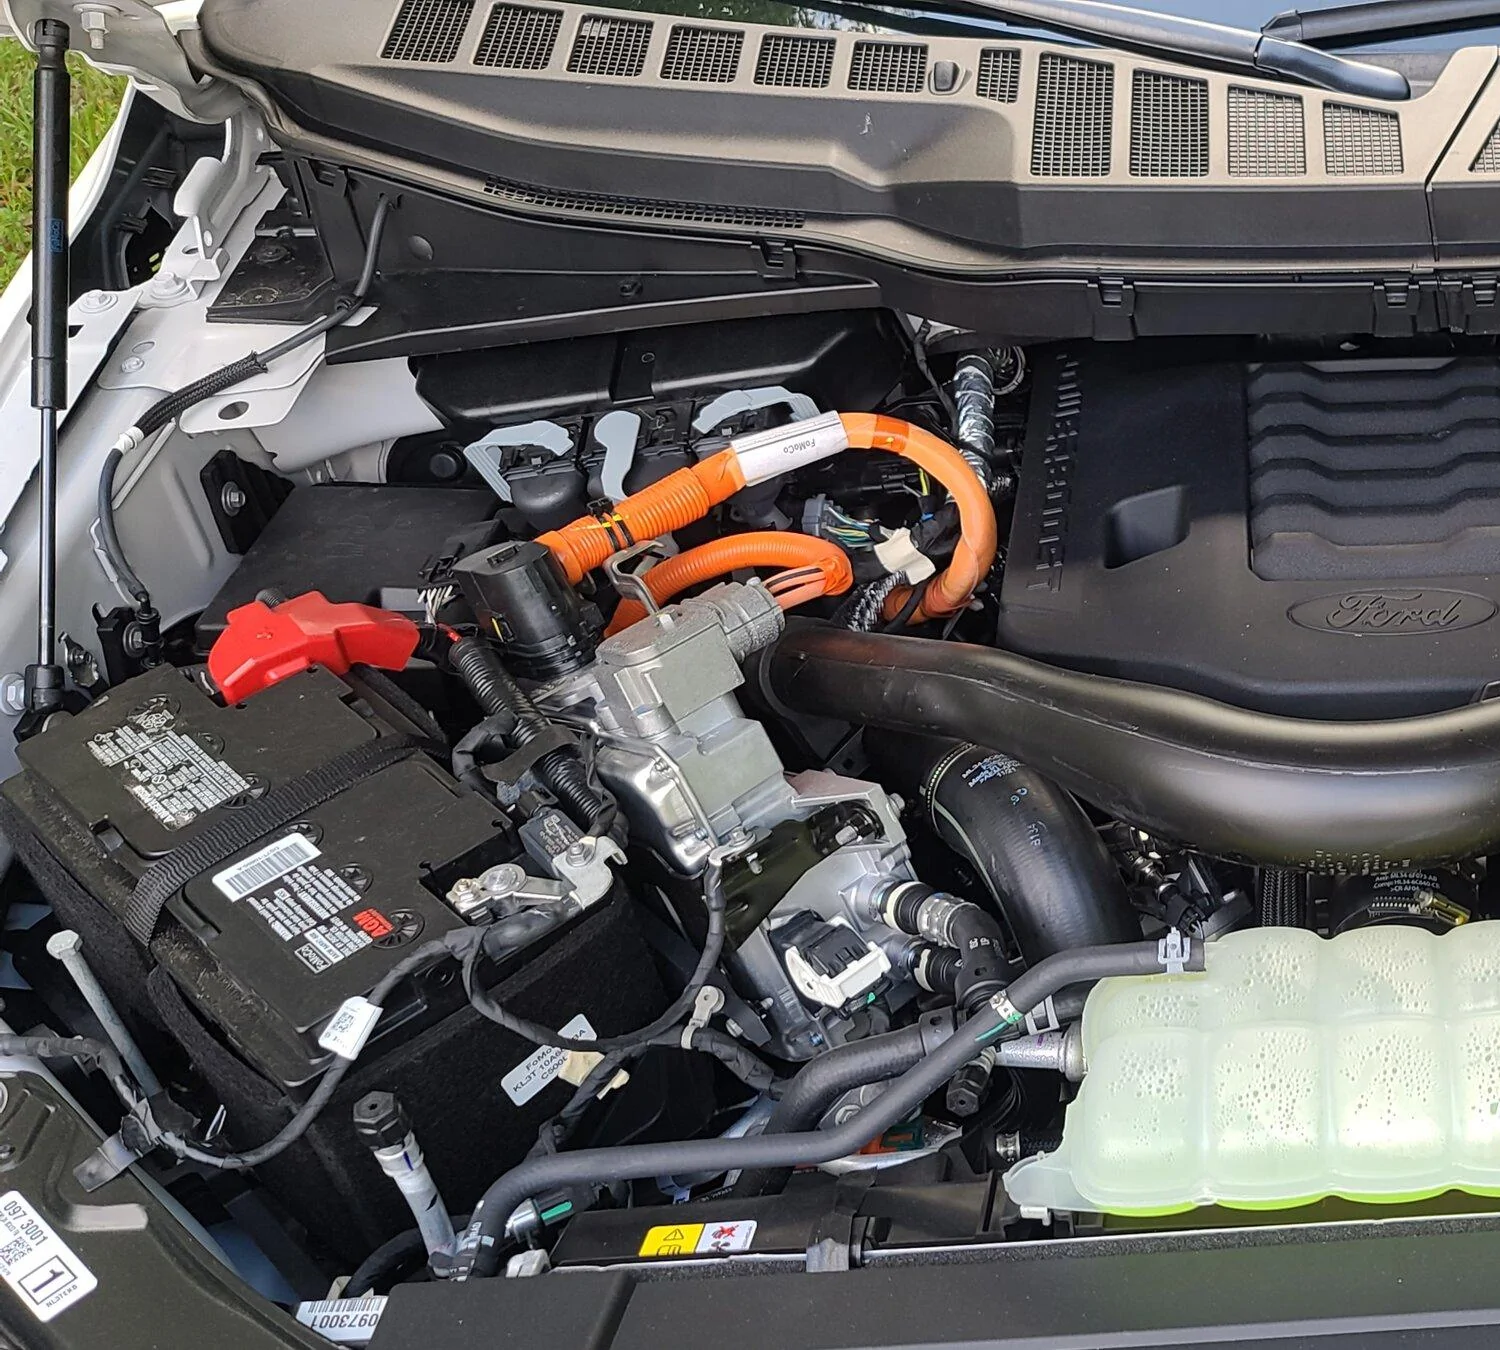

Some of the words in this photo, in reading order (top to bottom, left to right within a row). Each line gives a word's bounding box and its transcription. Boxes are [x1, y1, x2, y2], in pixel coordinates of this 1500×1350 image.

[783, 437, 817, 455] FoMoCo
[1325, 591, 1463, 630] Ford
[353, 910, 388, 937] AGM
[301, 946, 326, 969] FoMoCo
[513, 1071, 537, 1092] KL3T
[3, 1200, 28, 1221] 097
[20, 1219, 48, 1246] 3001
[32, 1269, 65, 1293] 1
[311, 1313, 379, 1329] 0973001
